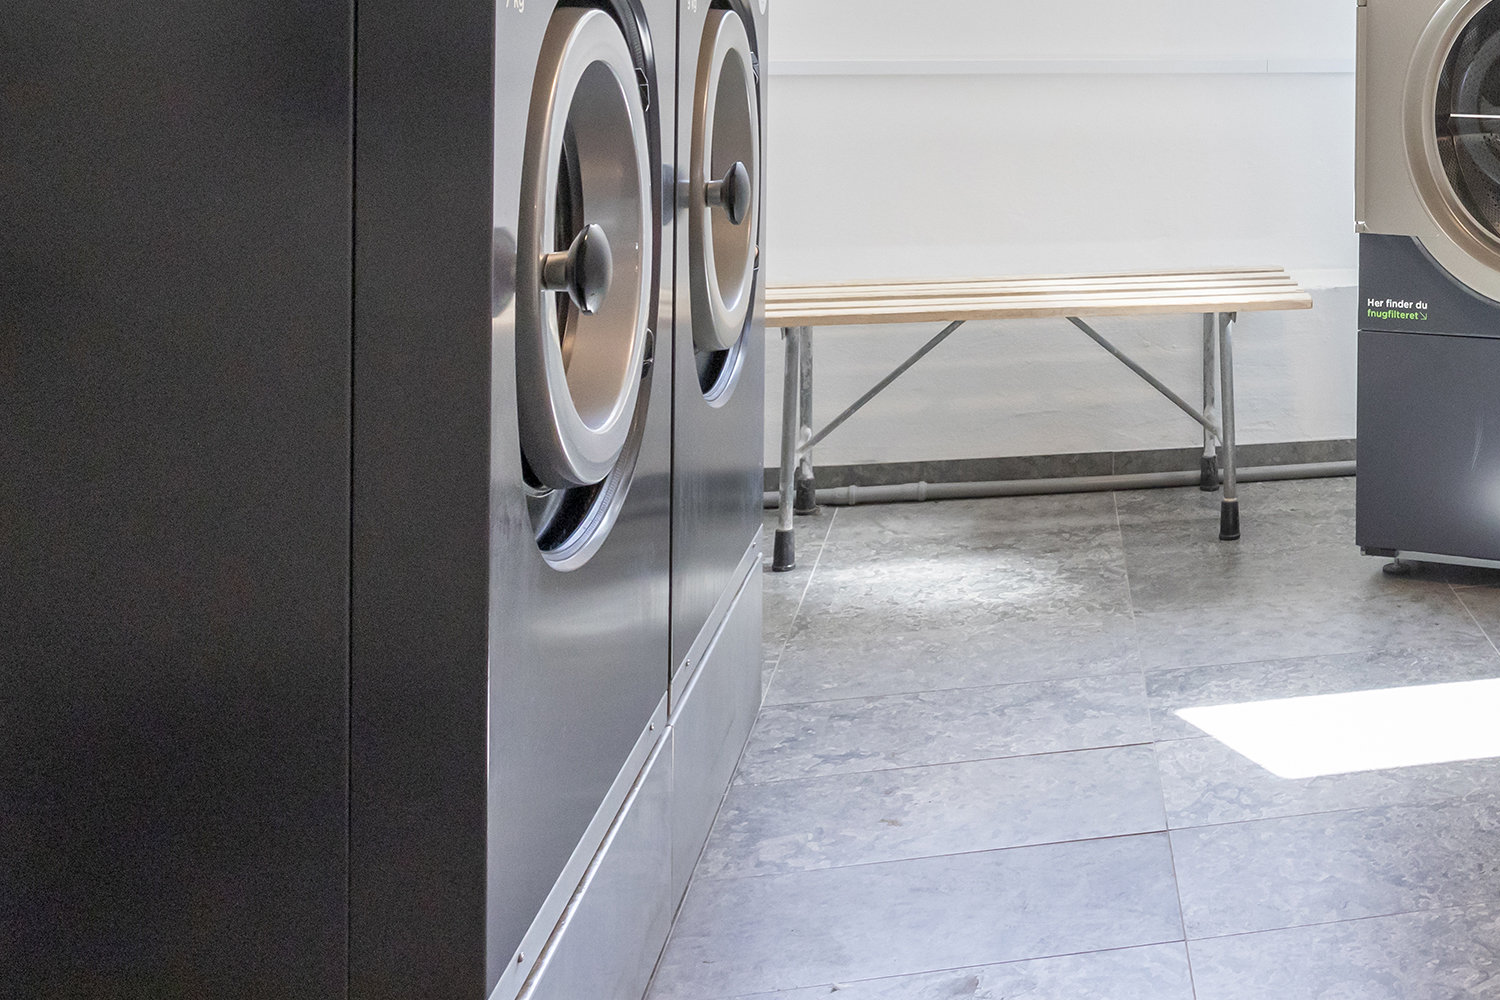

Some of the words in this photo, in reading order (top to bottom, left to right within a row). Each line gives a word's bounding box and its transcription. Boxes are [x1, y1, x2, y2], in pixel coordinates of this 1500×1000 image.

[1367, 298, 1384, 307] Her
[1386, 299, 1413, 309] finder
[1415, 301, 1428, 310] du
[1367, 308, 1419, 320] fnugfilteret
